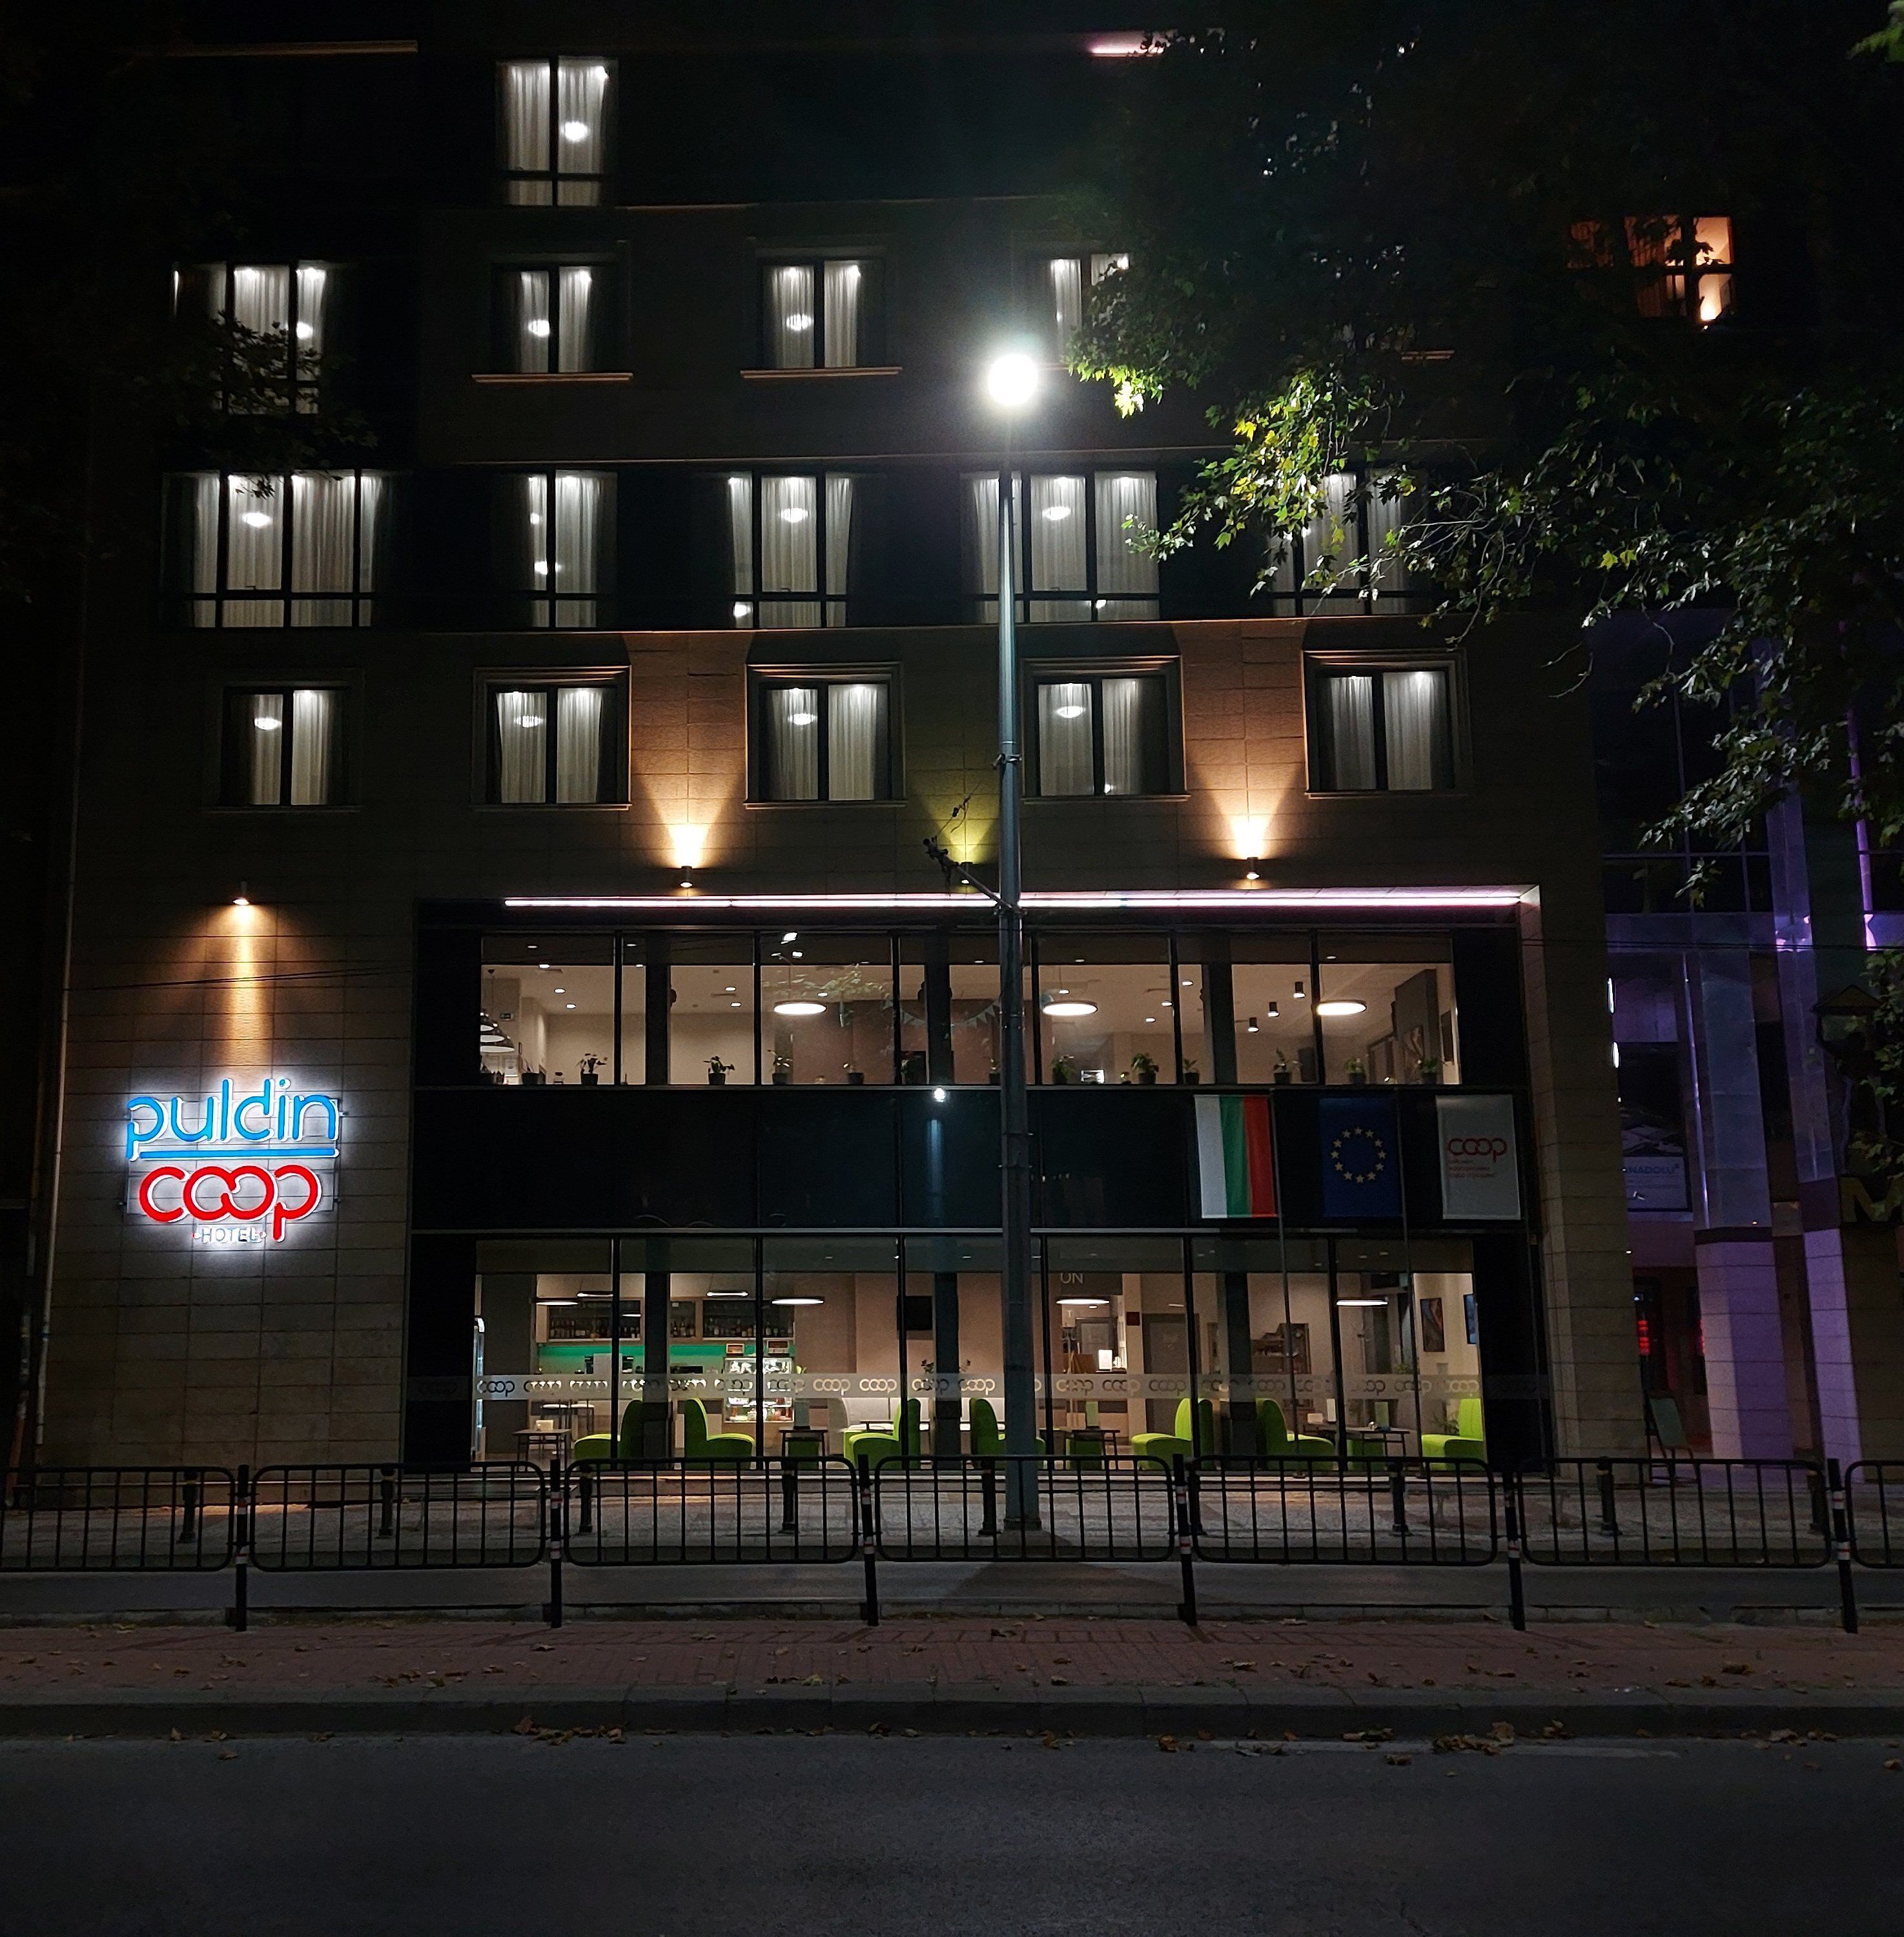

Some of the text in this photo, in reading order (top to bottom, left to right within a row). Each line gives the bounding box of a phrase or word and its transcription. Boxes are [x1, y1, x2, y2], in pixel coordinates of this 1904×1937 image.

[127, 1079, 338, 1161] puldin
[1447, 1138, 1508, 1163] coop
[139, 1165, 322, 1242] coop
[201, 1227, 261, 1244] HOTEL
[476, 1380, 515, 1397] coop
[813, 1378, 851, 1395] coop
[859, 1378, 897, 1394] coop
[958, 1378, 996, 1395] coop
